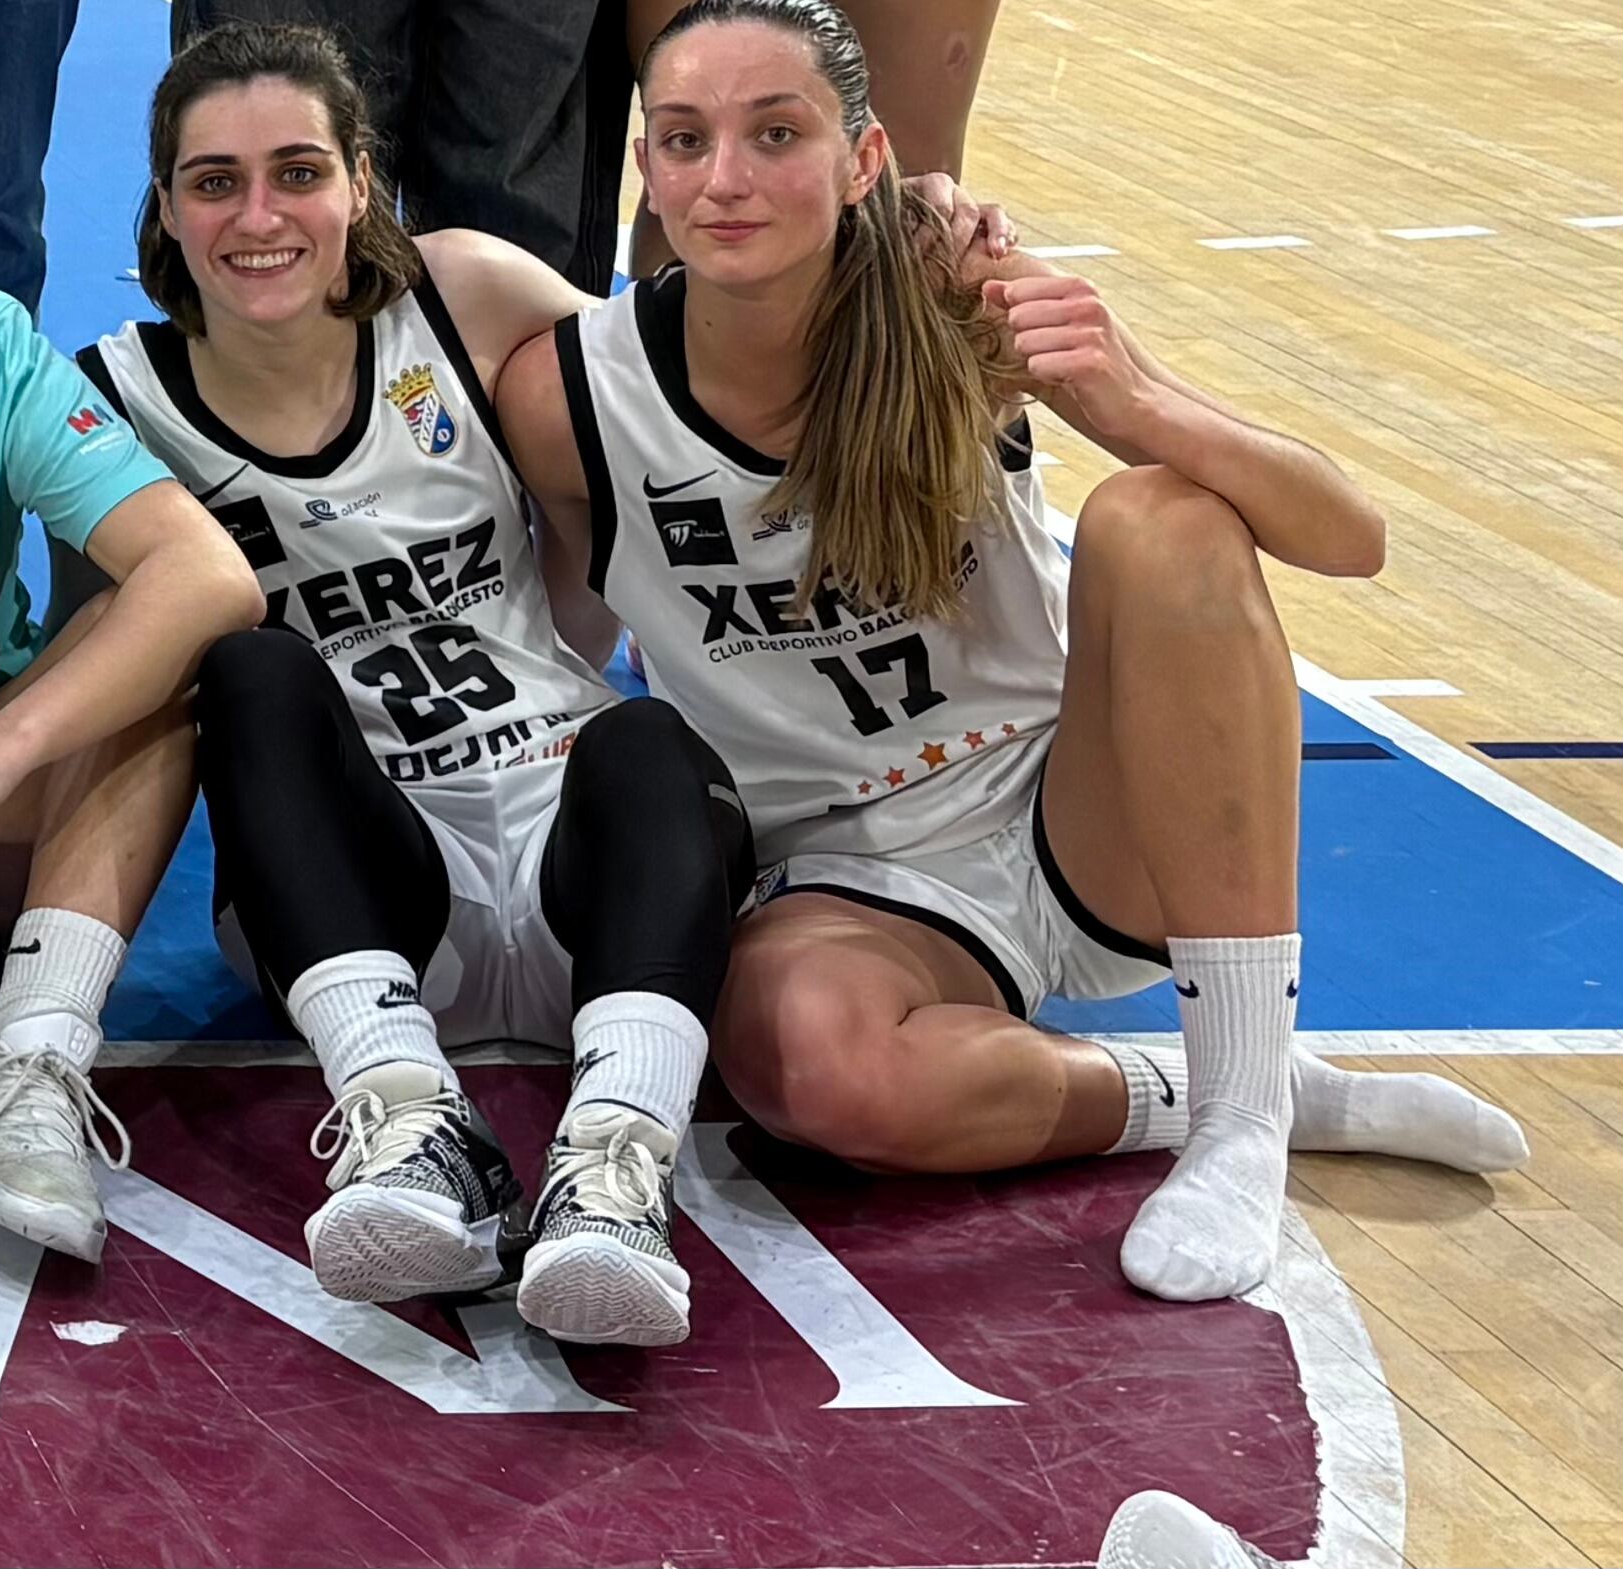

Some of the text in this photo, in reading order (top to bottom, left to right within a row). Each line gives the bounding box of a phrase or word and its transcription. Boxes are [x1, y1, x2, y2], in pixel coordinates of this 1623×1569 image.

[352, 625, 516, 746] 25
[708, 638, 754, 664] CLUB
[757, 629, 858, 653] DEPORTIVO
[810, 632, 949, 736] 17
